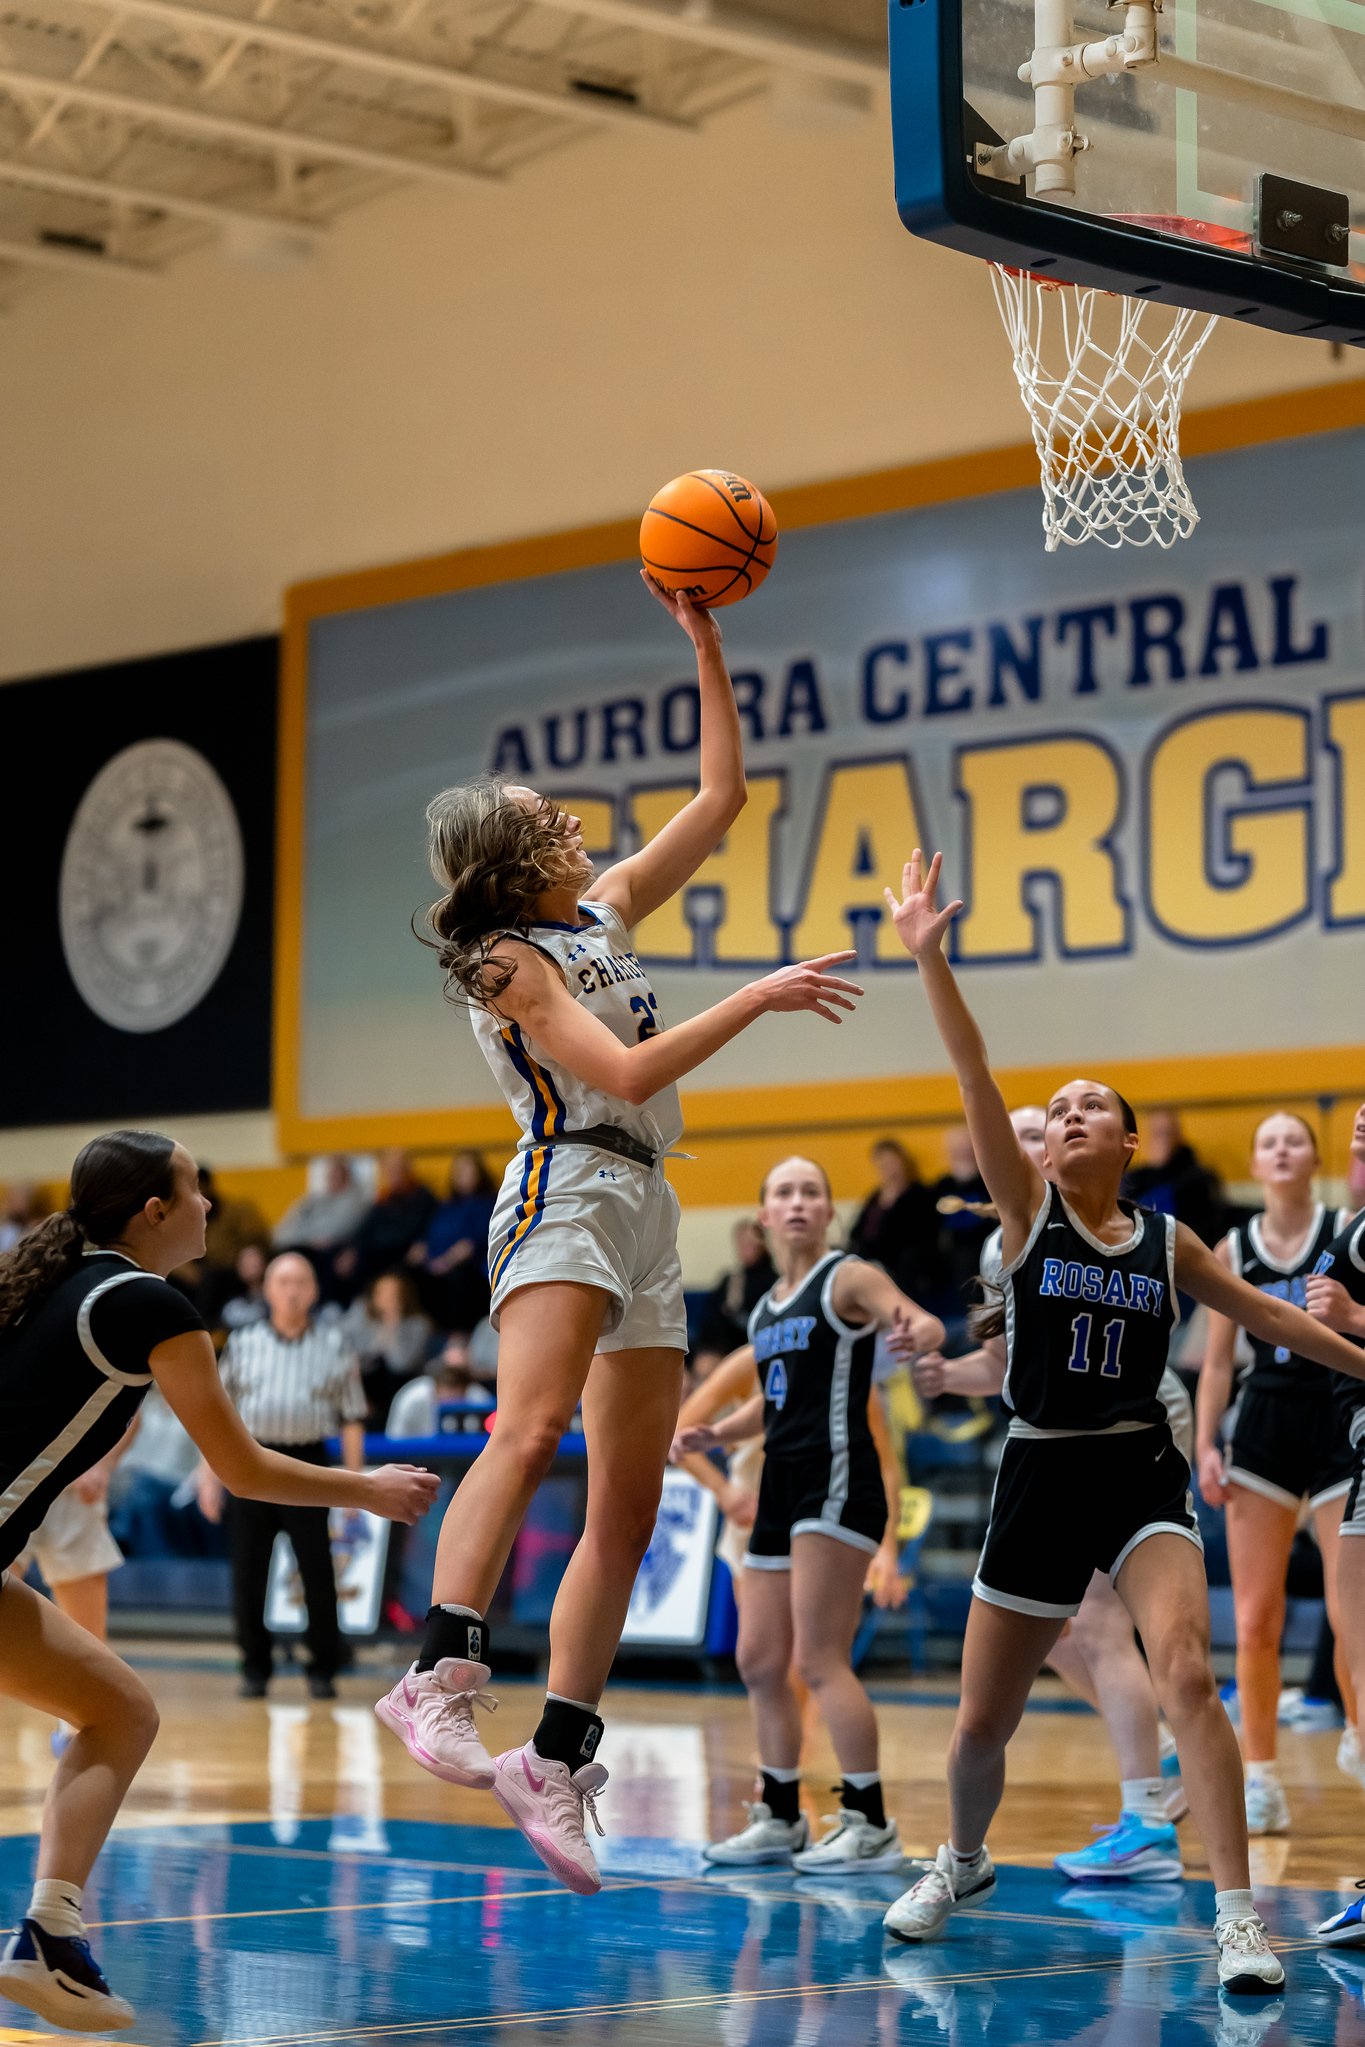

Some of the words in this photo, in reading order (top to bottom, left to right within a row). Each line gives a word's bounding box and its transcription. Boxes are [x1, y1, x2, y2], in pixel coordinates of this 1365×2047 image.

[490, 658, 829, 775] AURORA
[861, 574, 1329, 723] CENTRAL
[545, 690, 1365, 972] HARG
[630, 992, 658, 1042] 2
[1039, 1258, 1164, 1317] ROSARY
[1068, 1312, 1125, 1378] 11
[765, 1358, 788, 1410] 4
